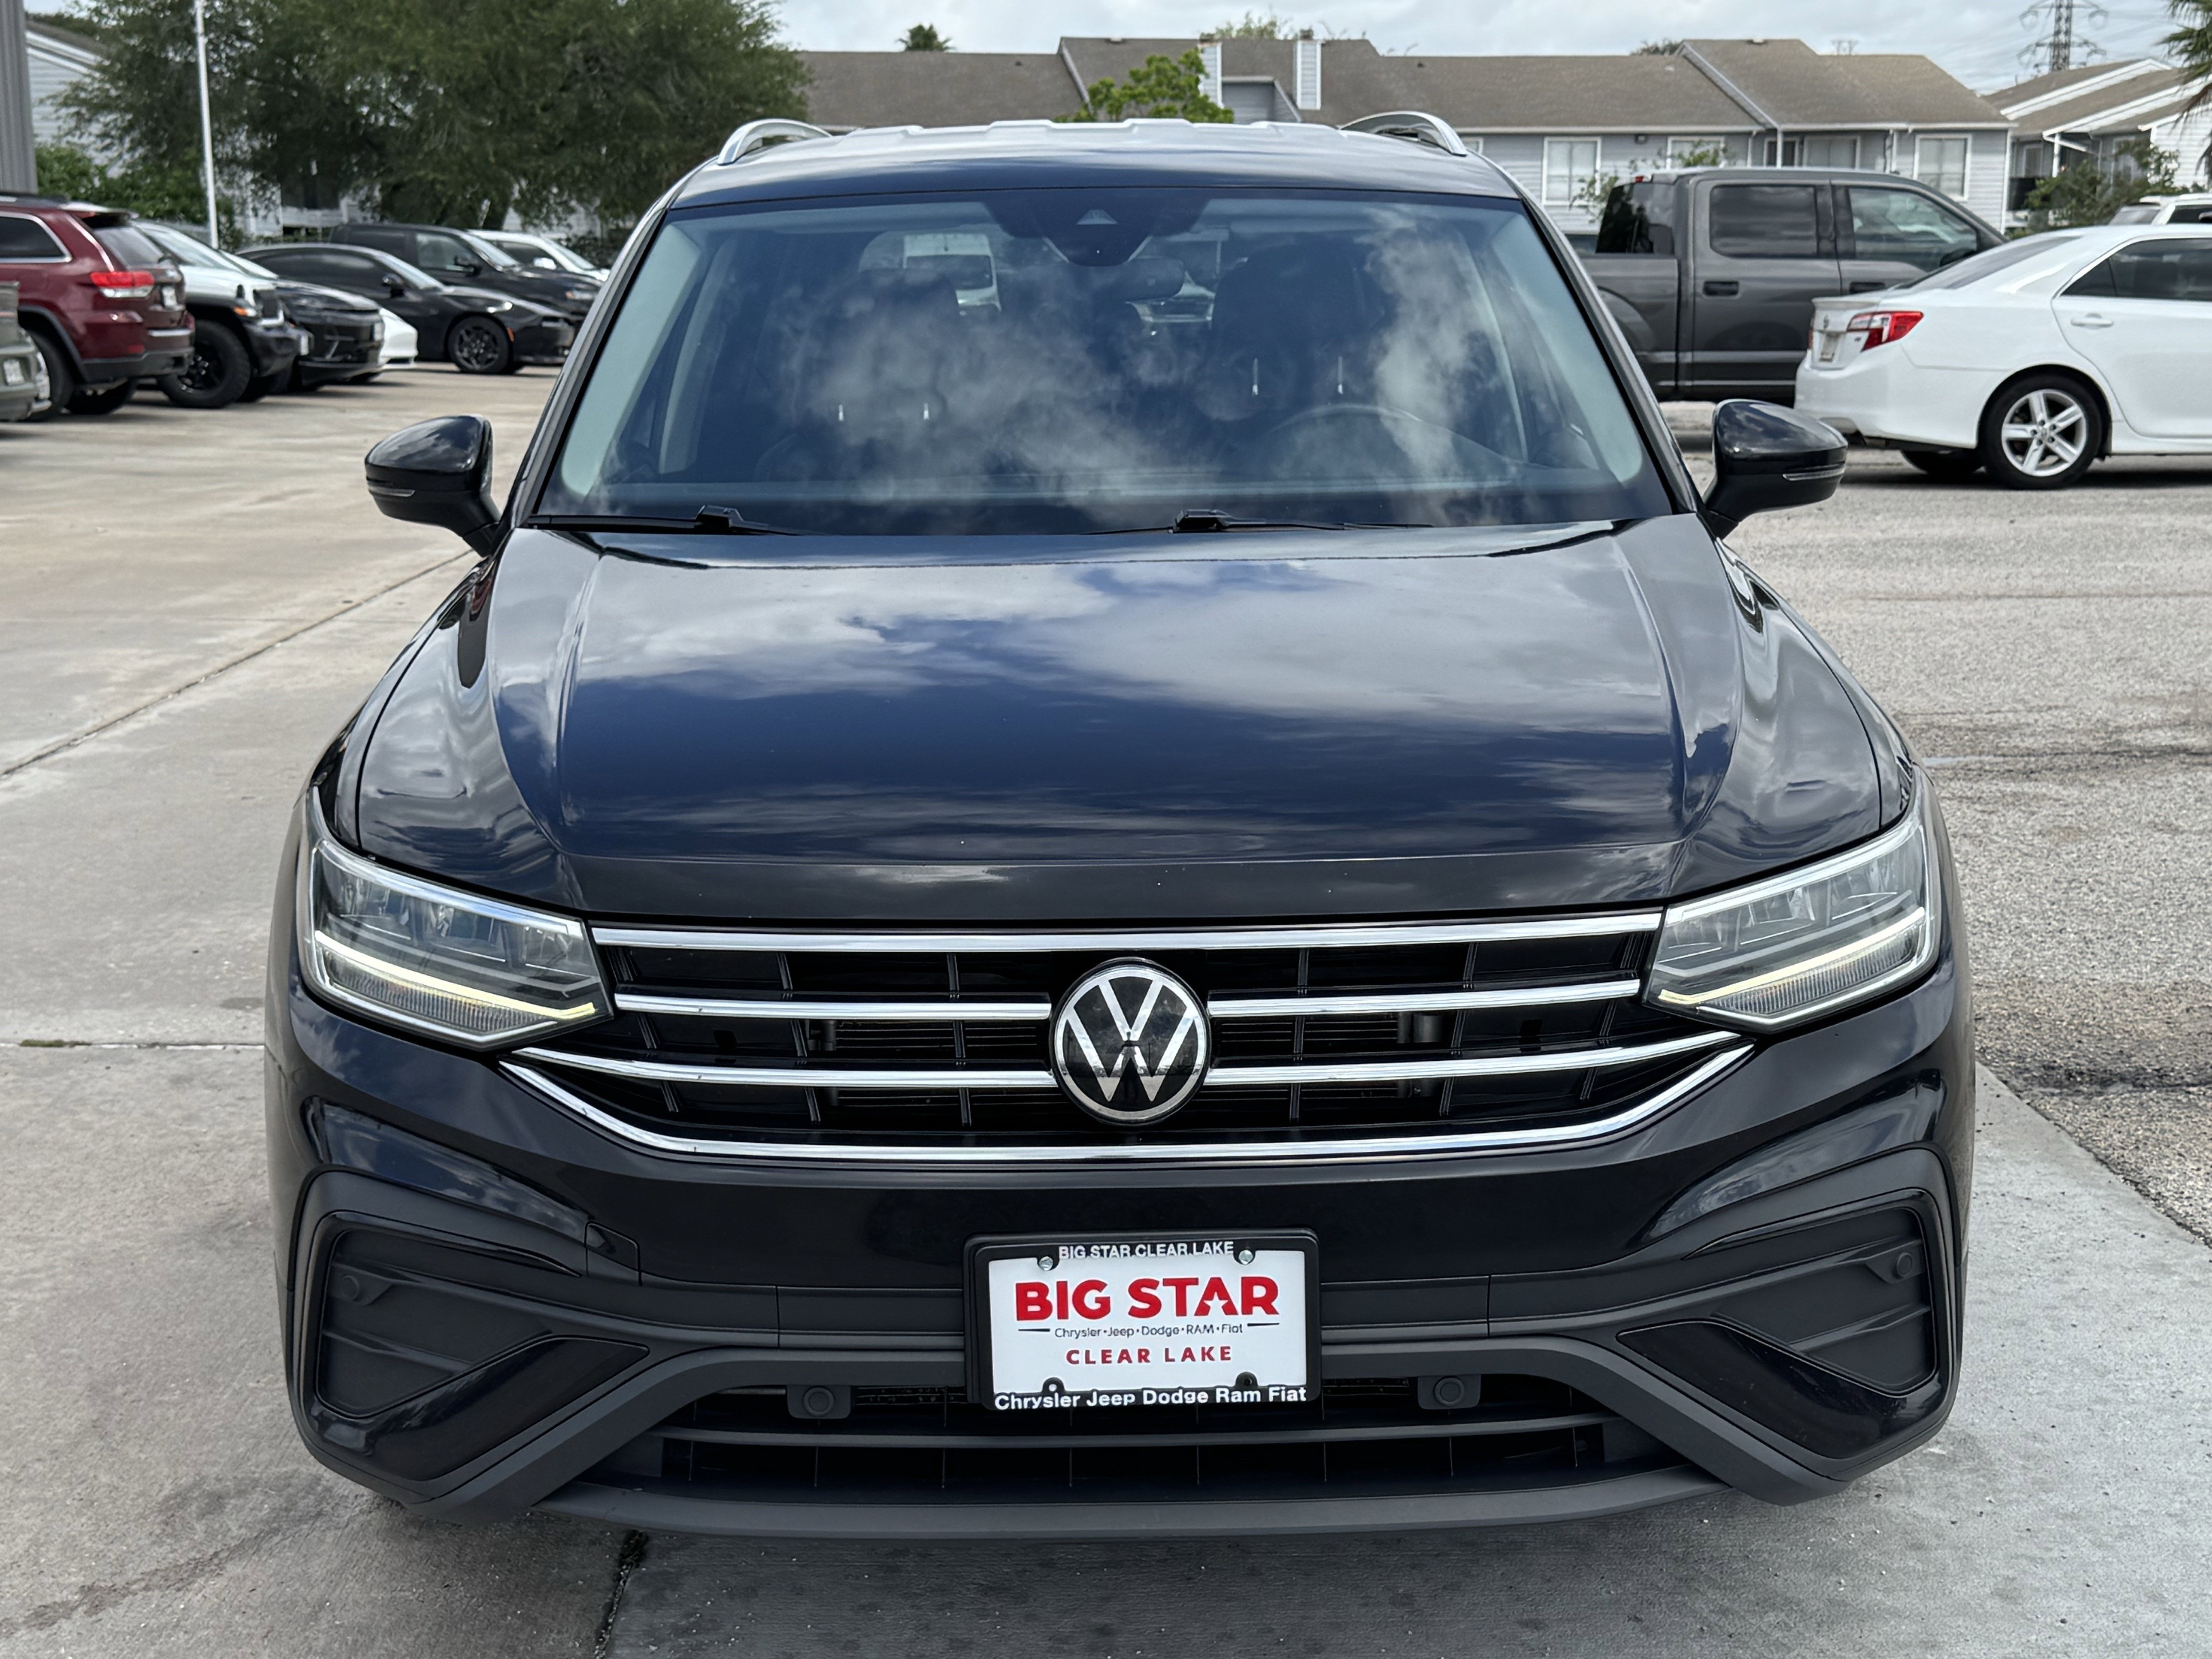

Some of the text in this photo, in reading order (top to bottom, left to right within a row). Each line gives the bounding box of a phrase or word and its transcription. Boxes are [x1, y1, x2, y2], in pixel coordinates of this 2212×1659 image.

[1058, 1241, 1234, 1259] BIG STAR CLEAR LAKE
[1015, 1276, 1279, 1321] BIG STAR
[1054, 1327, 1102, 1339] Chrysler
[1186, 1324, 1215, 1334] RAM
[1066, 1346, 1231, 1365] CLEAR LAKE
[994, 1386, 1307, 1410] Chrysler Jeep Dodge Ram Fiat
